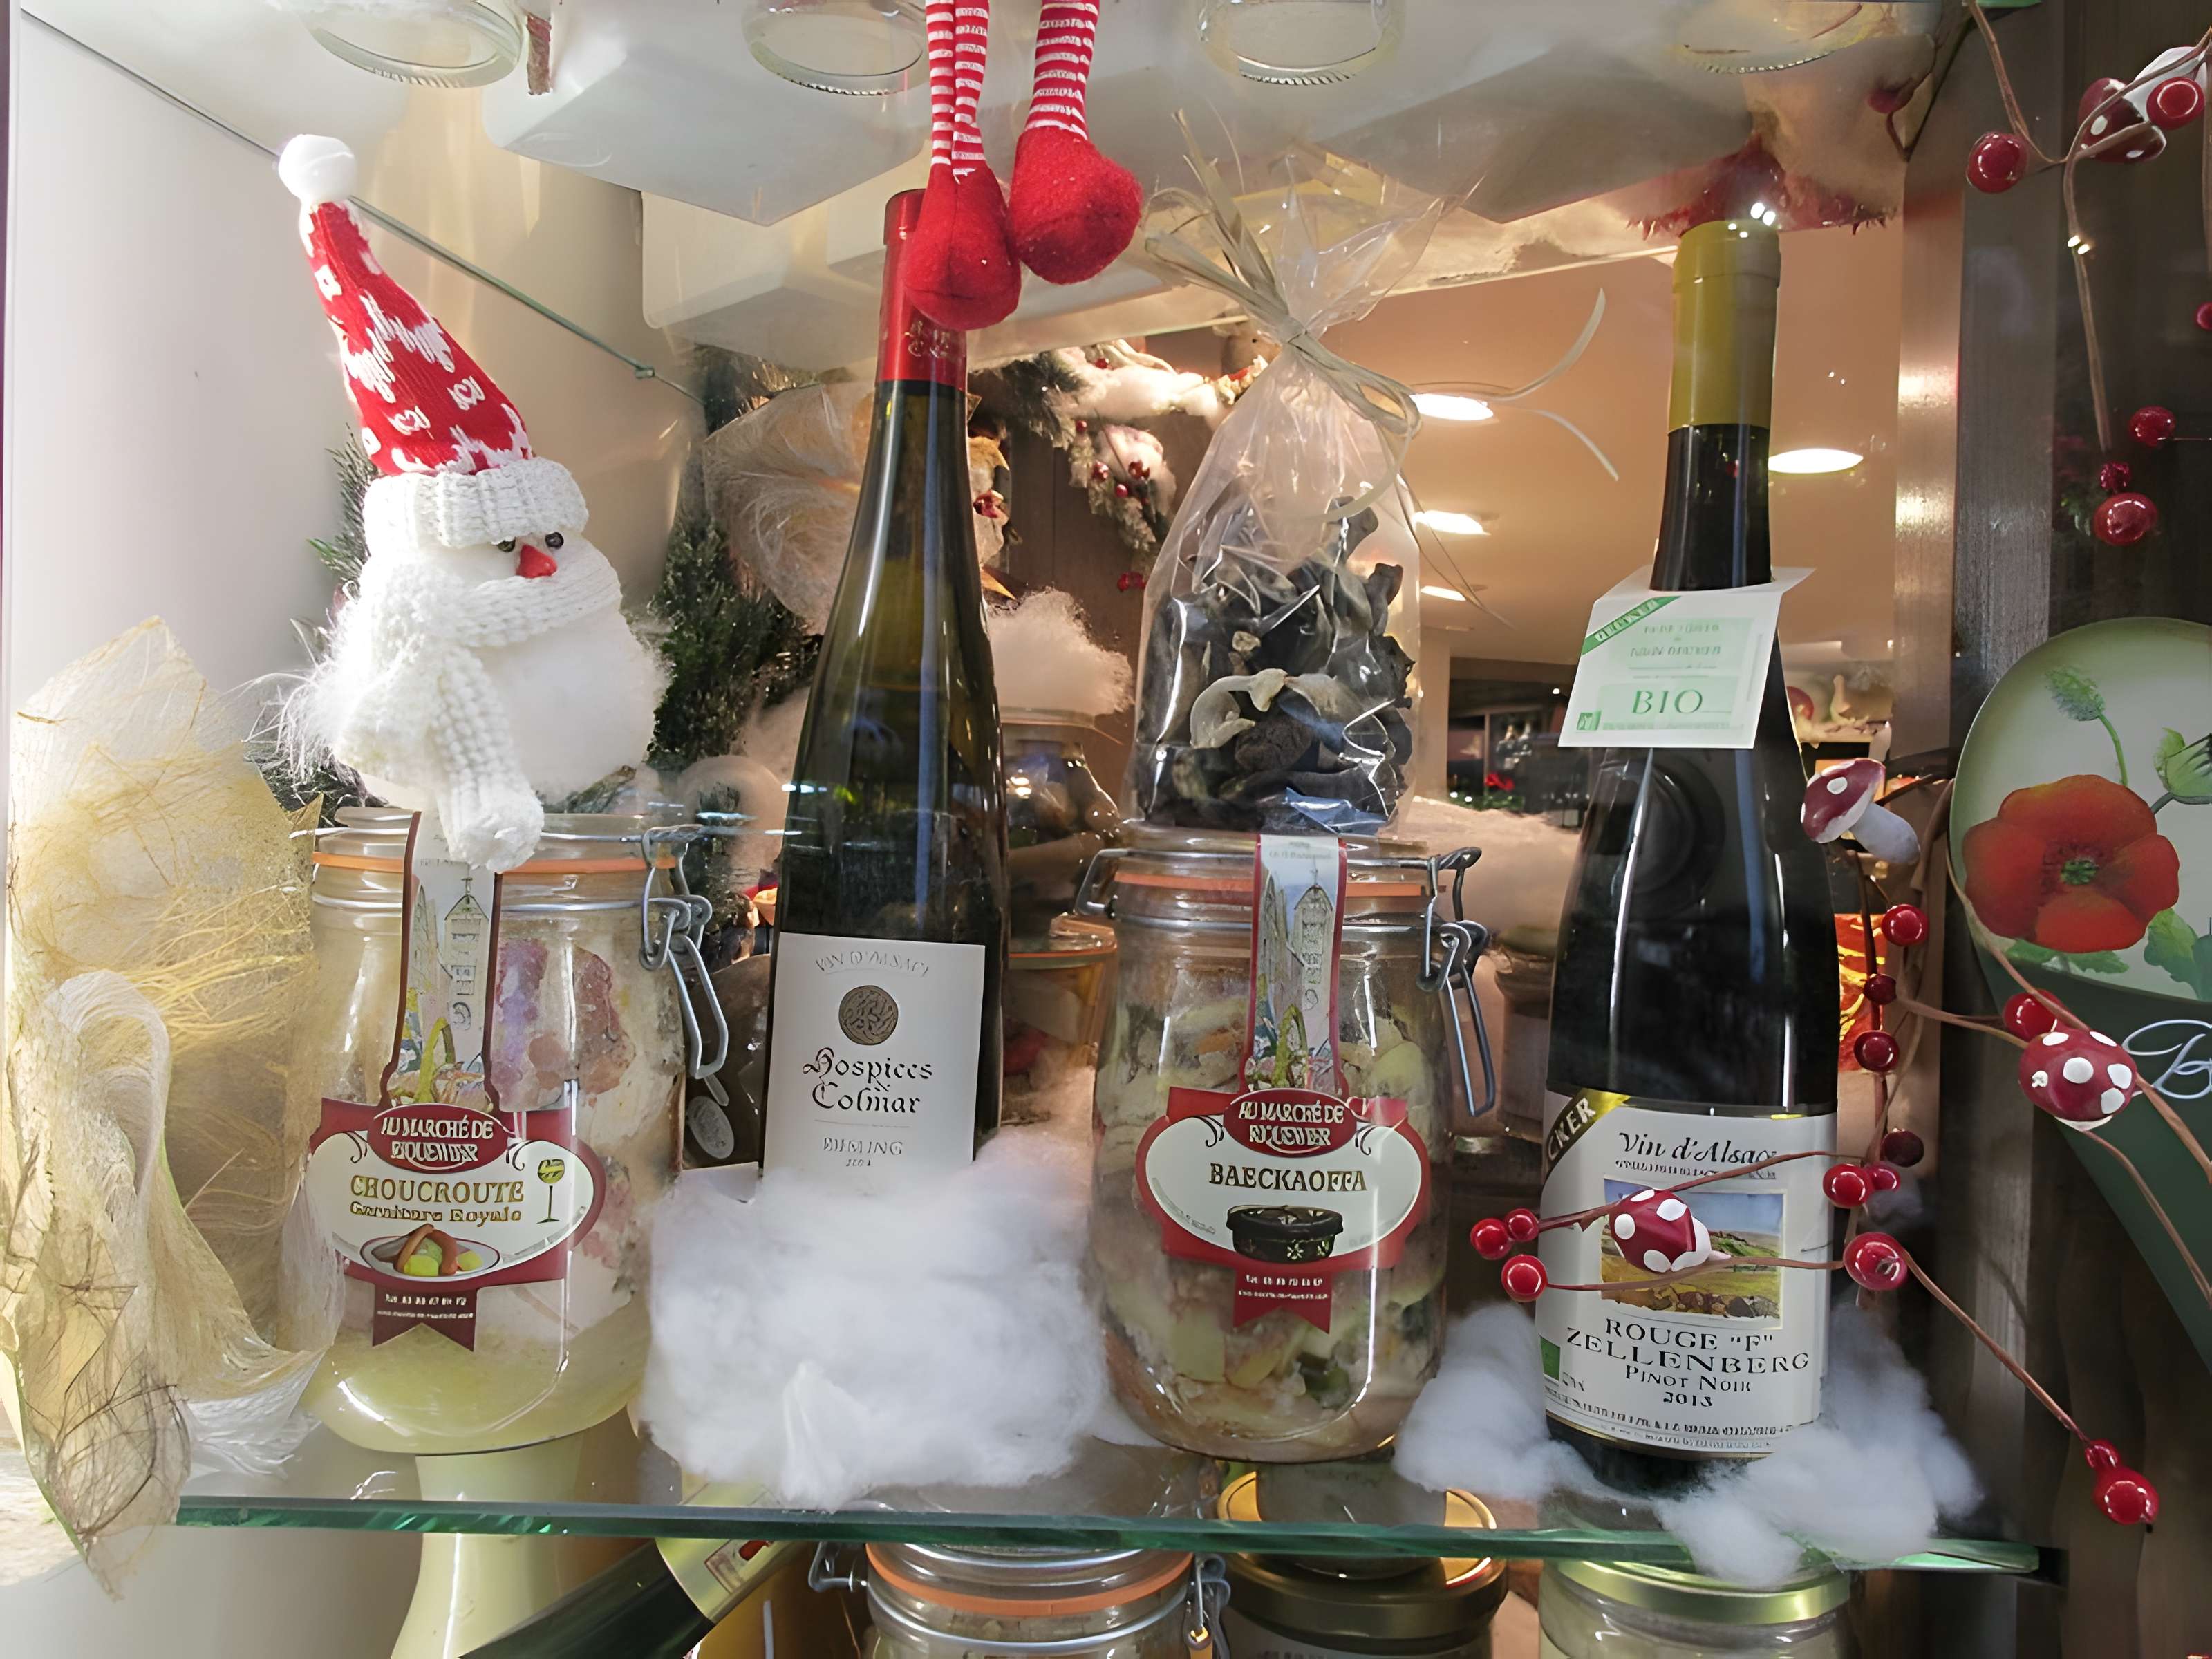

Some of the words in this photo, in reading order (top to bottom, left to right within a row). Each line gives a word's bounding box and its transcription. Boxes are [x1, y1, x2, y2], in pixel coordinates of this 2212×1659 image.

[1631, 689, 1703, 715] BIO
[802, 1047, 933, 1092] Hospices
[812, 1080, 921, 1114] Colmar
[471, 1119, 494, 1140] DE
[1324, 1105, 1345, 1124] DE
[1619, 1132, 1666, 1158] Vin
[1671, 1136, 1778, 1165] d'Alsac
[350, 1174, 525, 1203] CHOUCROUTE
[1208, 1162, 1368, 1192] BAECKAOFFA
[1605, 1318, 1718, 1350] ROUGE
[1566, 1327, 1809, 1374] ZELLENBERG
